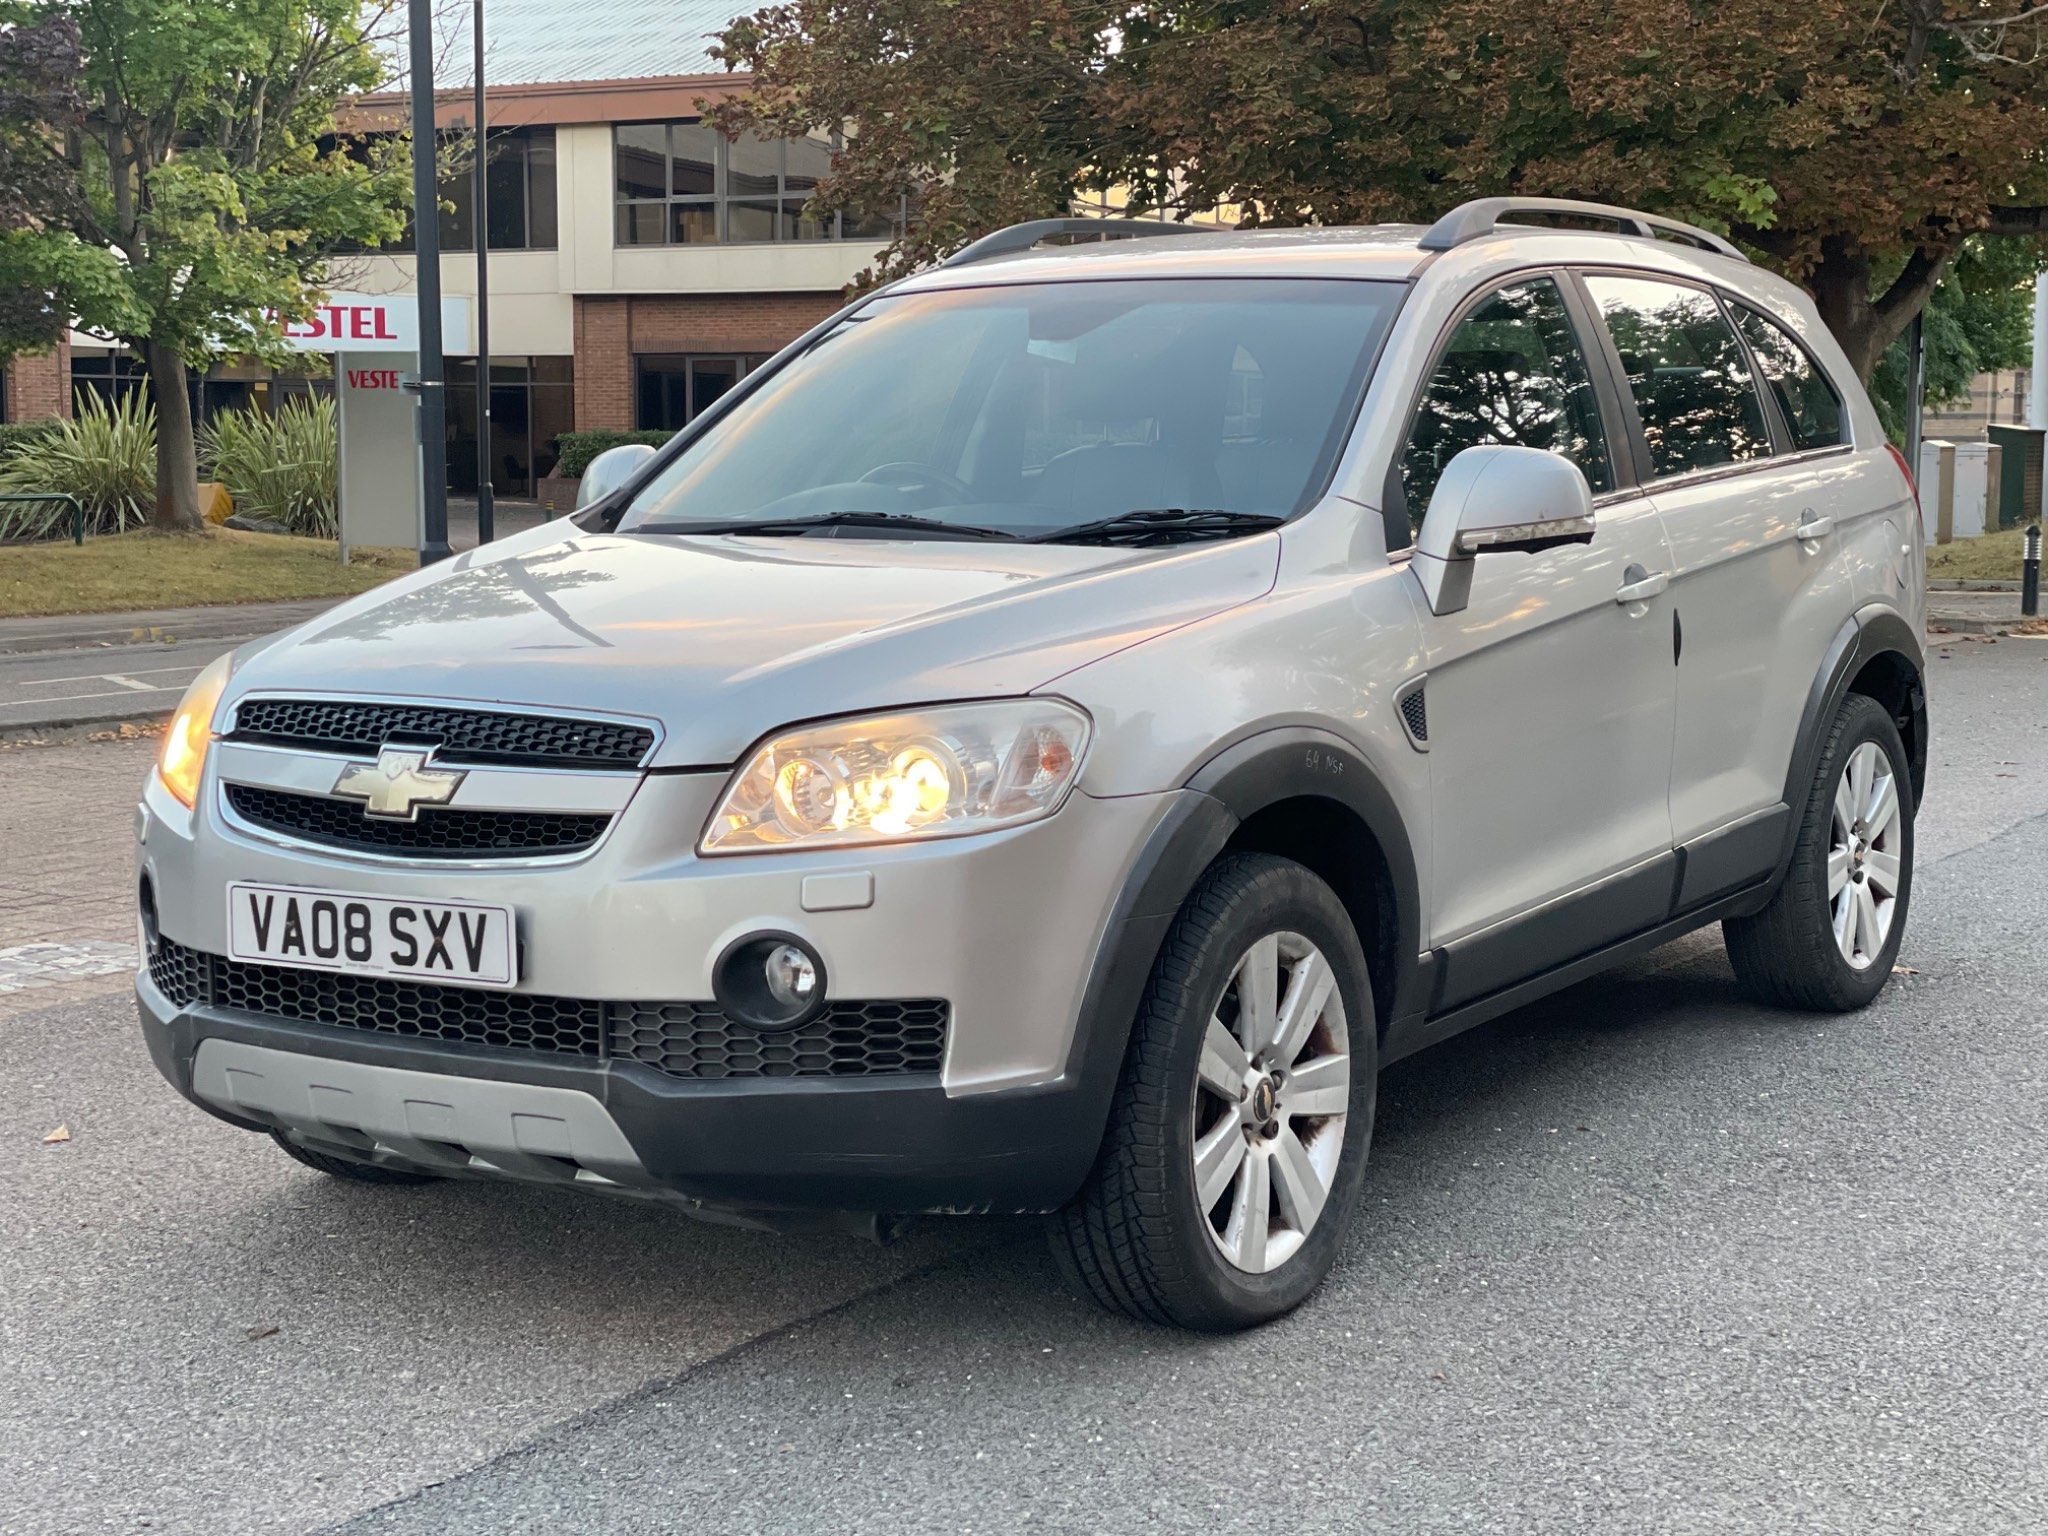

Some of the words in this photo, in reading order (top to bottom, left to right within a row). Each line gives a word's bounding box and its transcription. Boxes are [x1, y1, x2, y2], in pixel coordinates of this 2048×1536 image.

[348, 370, 403, 389] VESTE
[249, 893, 372, 962] VA08
[389, 906, 487, 973] SXV
